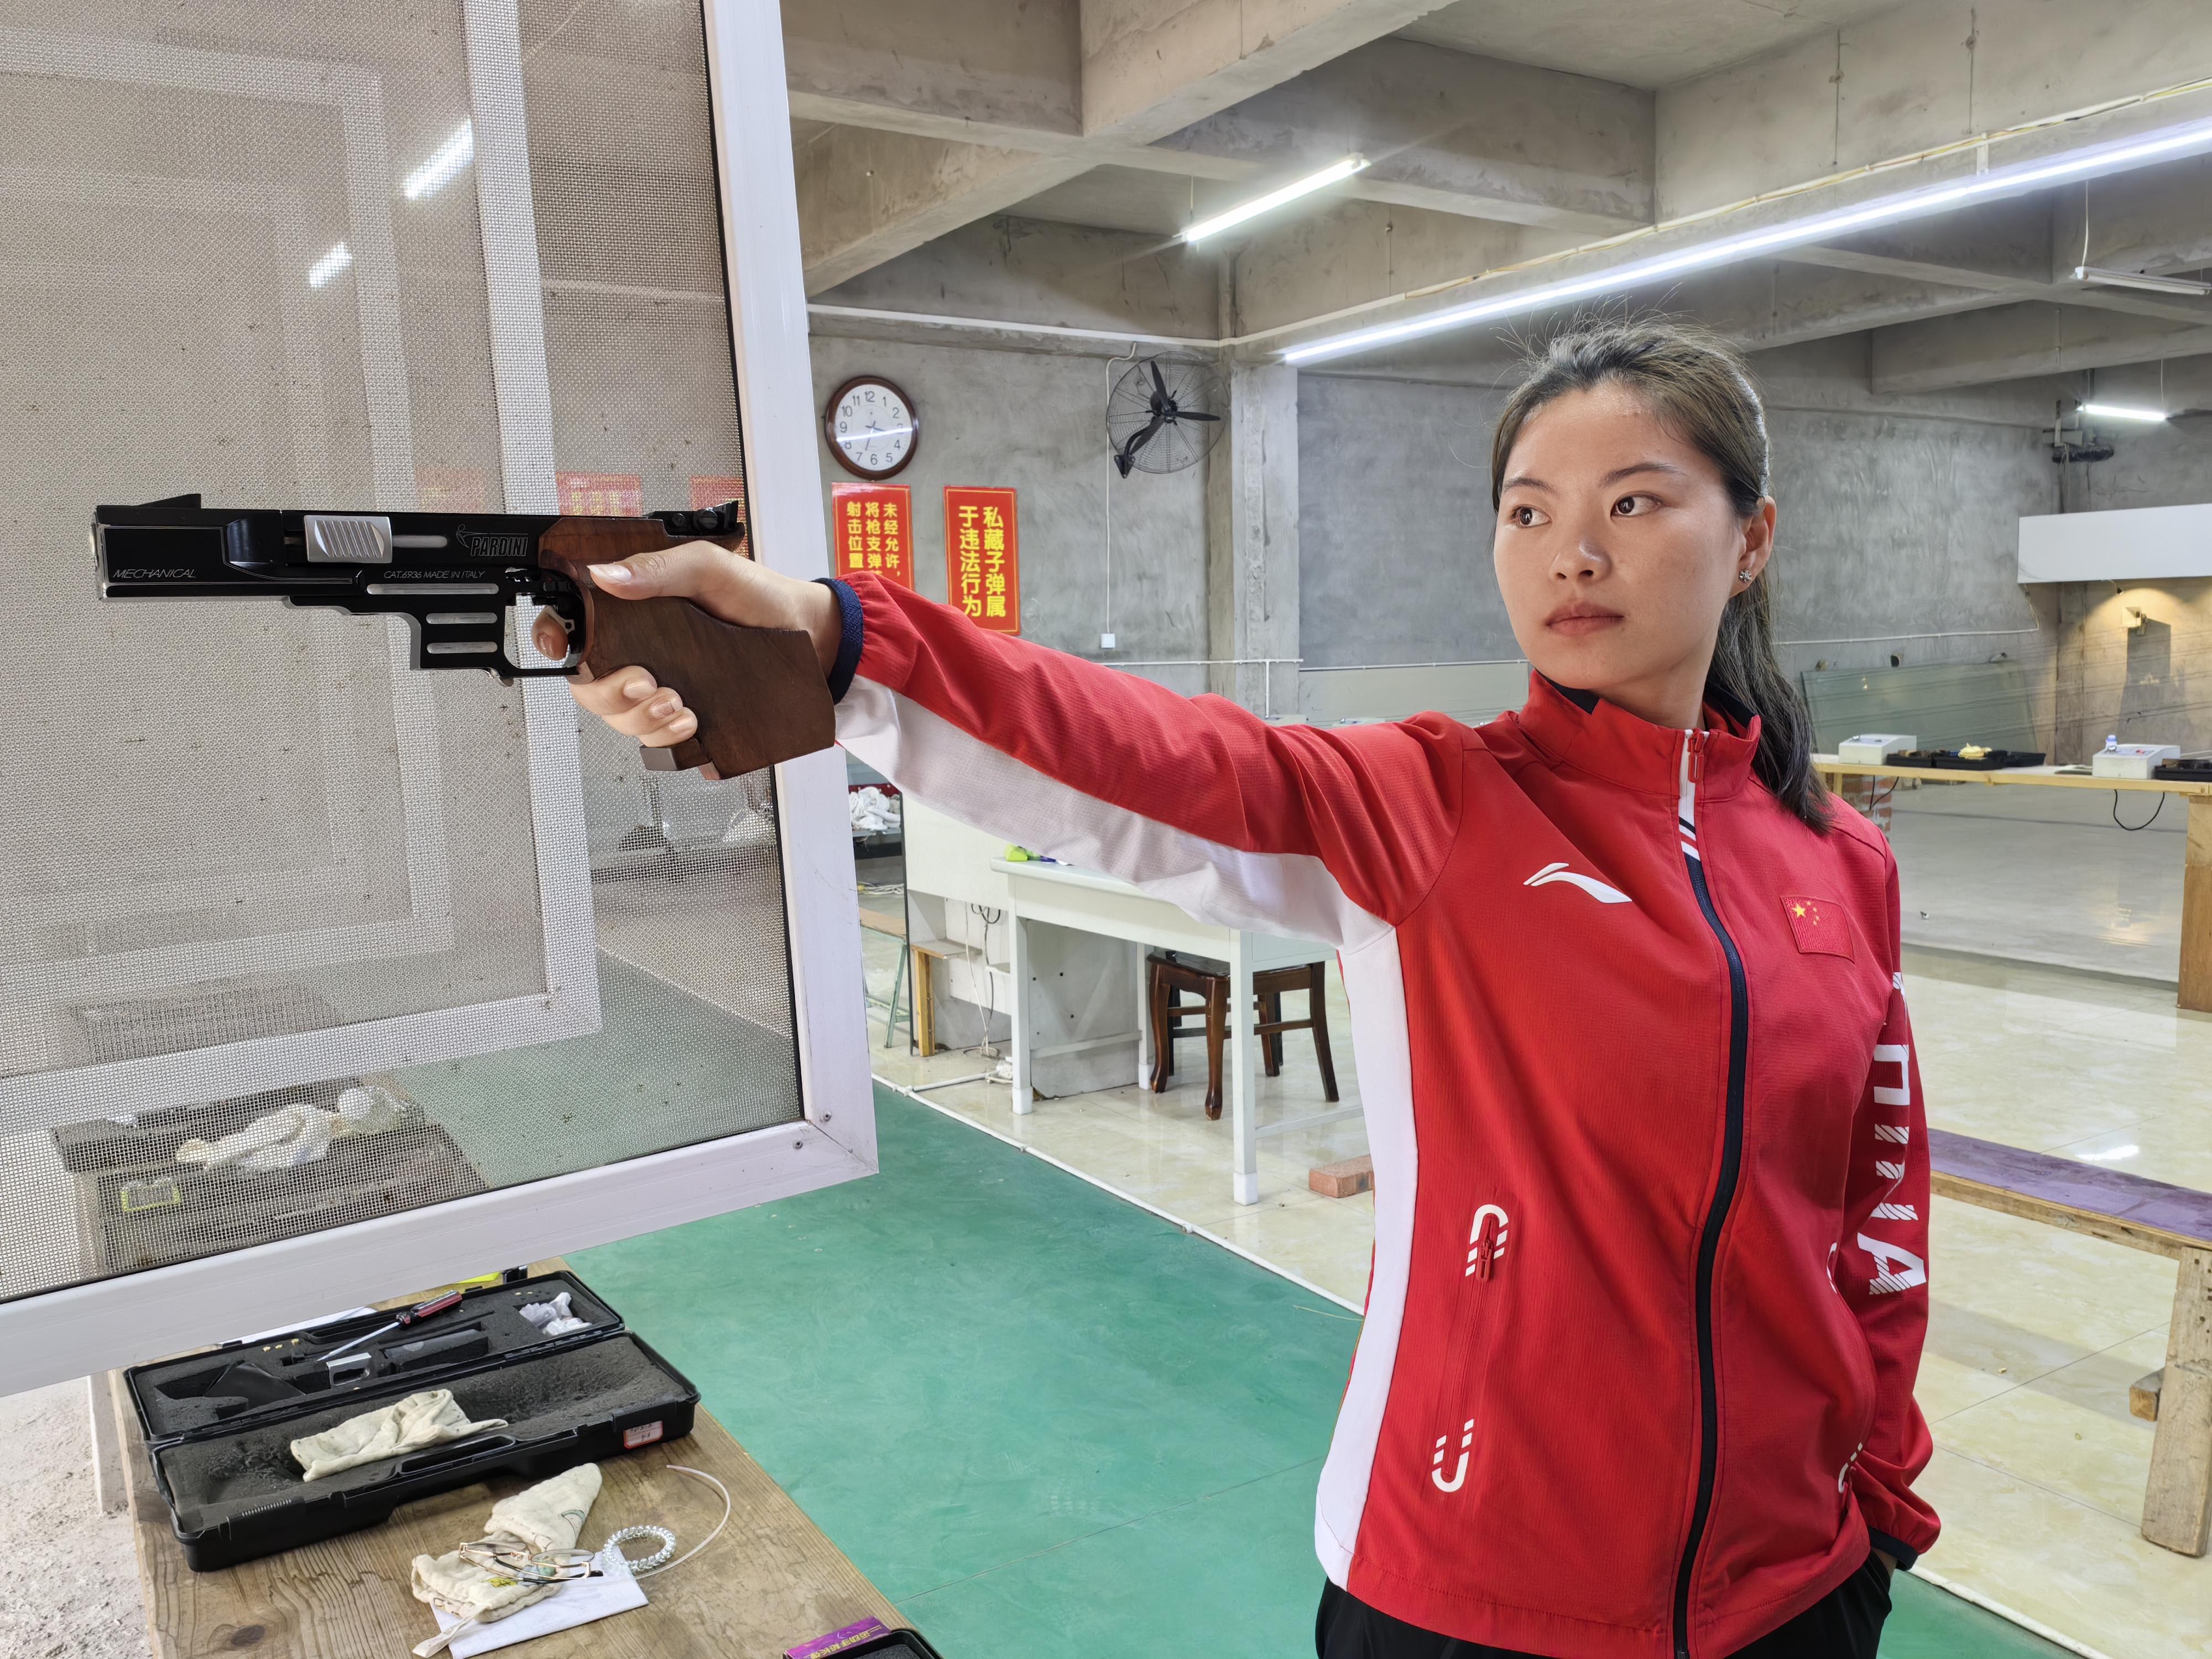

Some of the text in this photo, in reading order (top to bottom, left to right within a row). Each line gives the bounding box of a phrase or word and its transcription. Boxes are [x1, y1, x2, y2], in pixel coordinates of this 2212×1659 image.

[852, 395, 860, 406] 11
[864, 390, 875, 403] 12
[882, 396, 887, 407] 1
[842, 405, 853, 417] 10
[893, 406, 900, 419] 2
[839, 421, 847, 433] 9
[894, 439, 901, 450] 4
[855, 452, 863, 462] 7
[870, 453, 878, 465] 6
[885, 452, 893, 462] 5
[846, 501, 864, 568] 射击位置
[470, 536, 529, 556] PARDINI
[958, 505, 982, 618] 于违法行为
[983, 506, 1006, 618] 私藏子弹属
[113, 568, 197, 578] MECHANICAL
